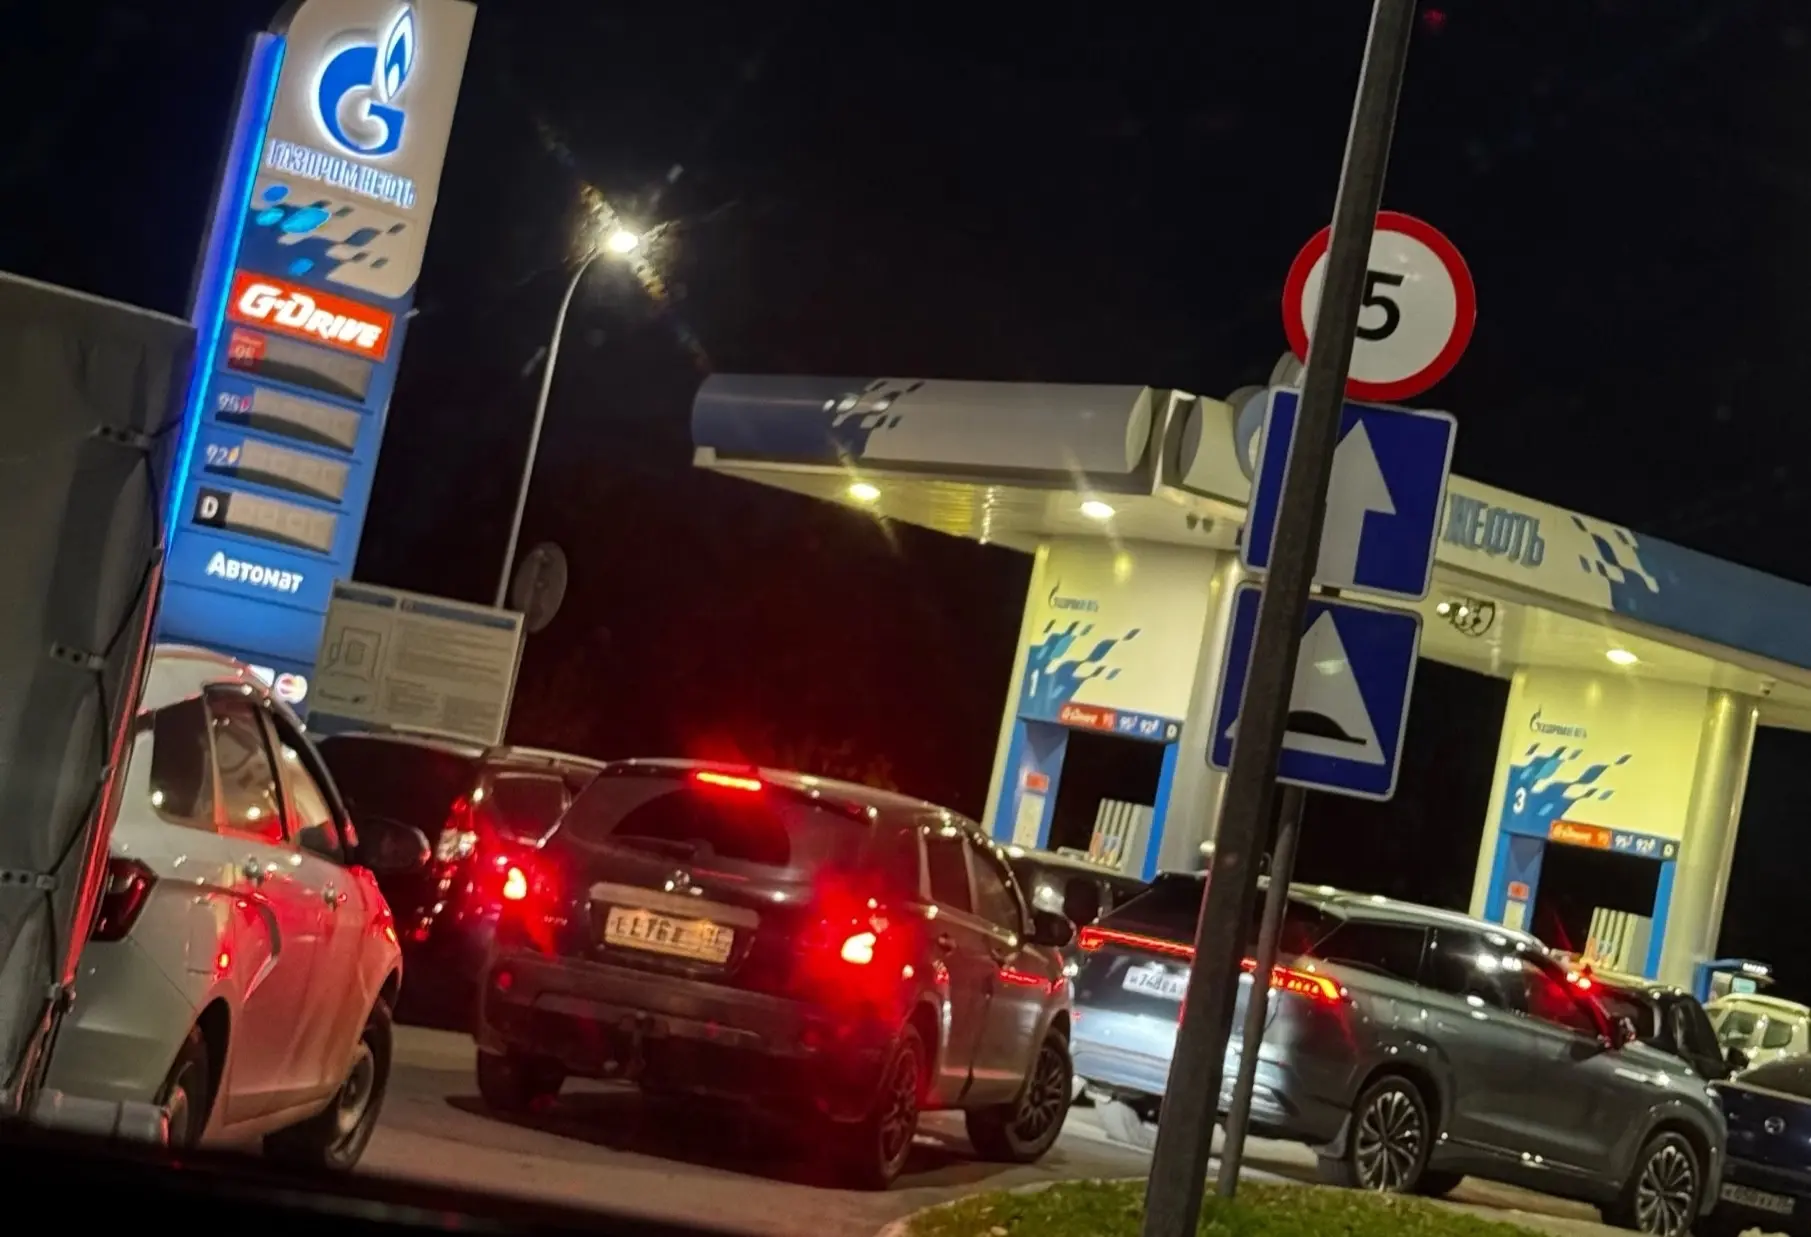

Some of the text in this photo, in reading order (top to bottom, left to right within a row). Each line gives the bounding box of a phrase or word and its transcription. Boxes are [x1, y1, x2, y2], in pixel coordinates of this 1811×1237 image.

[266, 139, 417, 209] ГАЗПРОМ НЕФТЬ
[1356, 269, 1405, 342] 5
[206, 444, 228, 466] 92
[201, 496, 219, 519] D
[1513, 787, 1526, 815] 3
